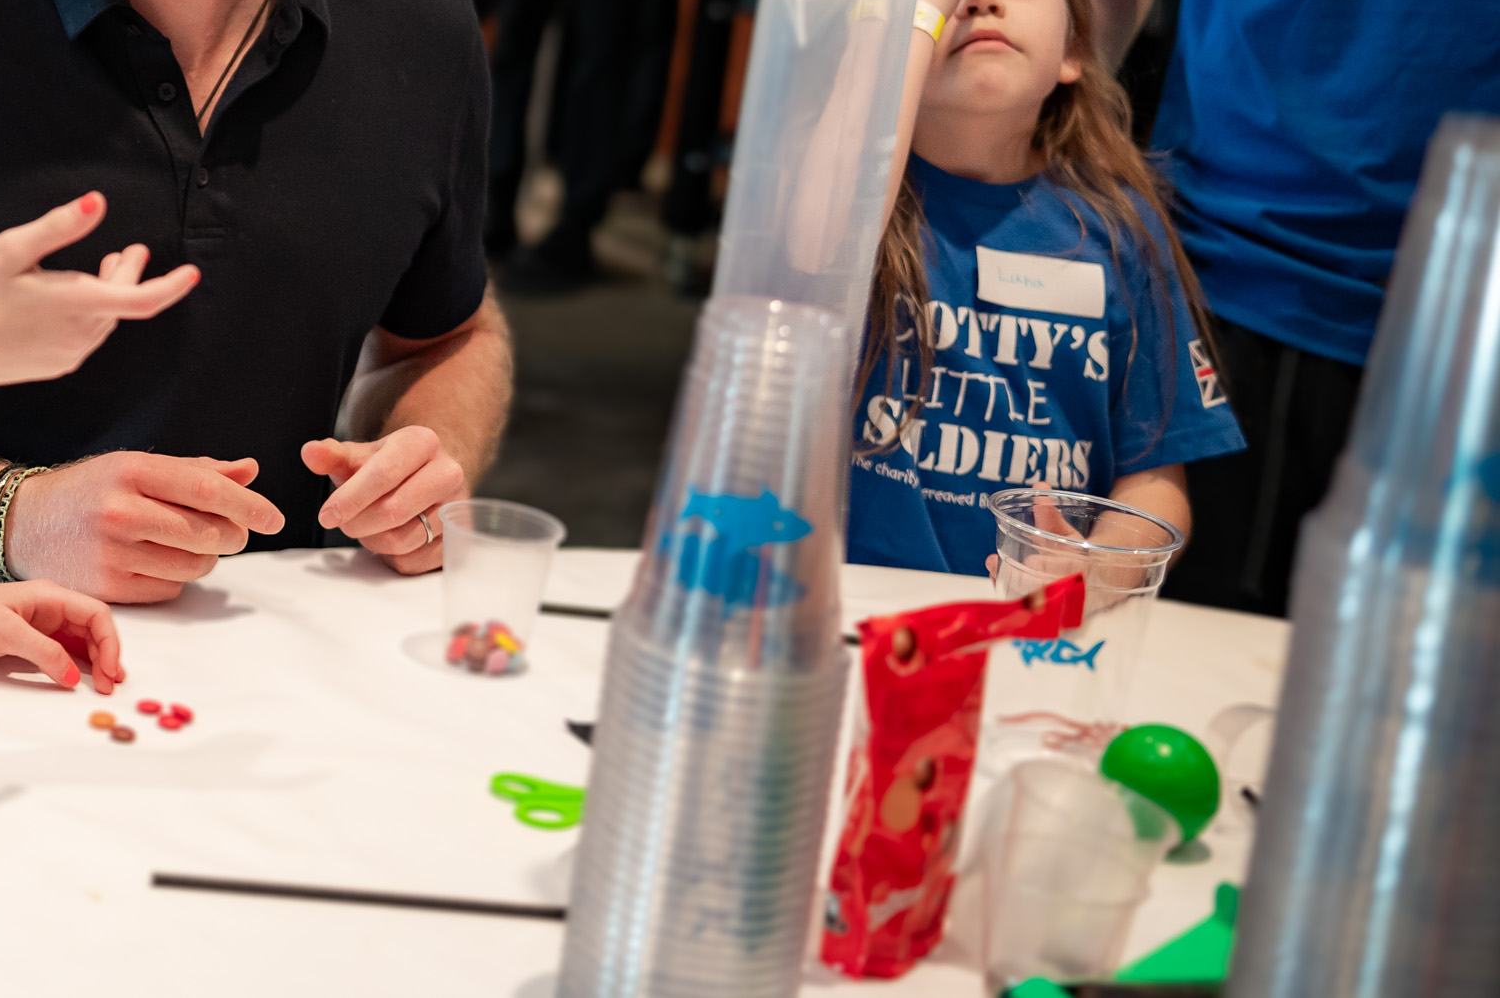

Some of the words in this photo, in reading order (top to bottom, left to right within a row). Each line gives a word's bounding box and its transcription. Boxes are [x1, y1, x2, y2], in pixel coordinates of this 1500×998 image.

[901, 358, 1052, 425] LITTLE
[874, 461, 920, 490] charity
[920, 487, 976, 508] ereaved
